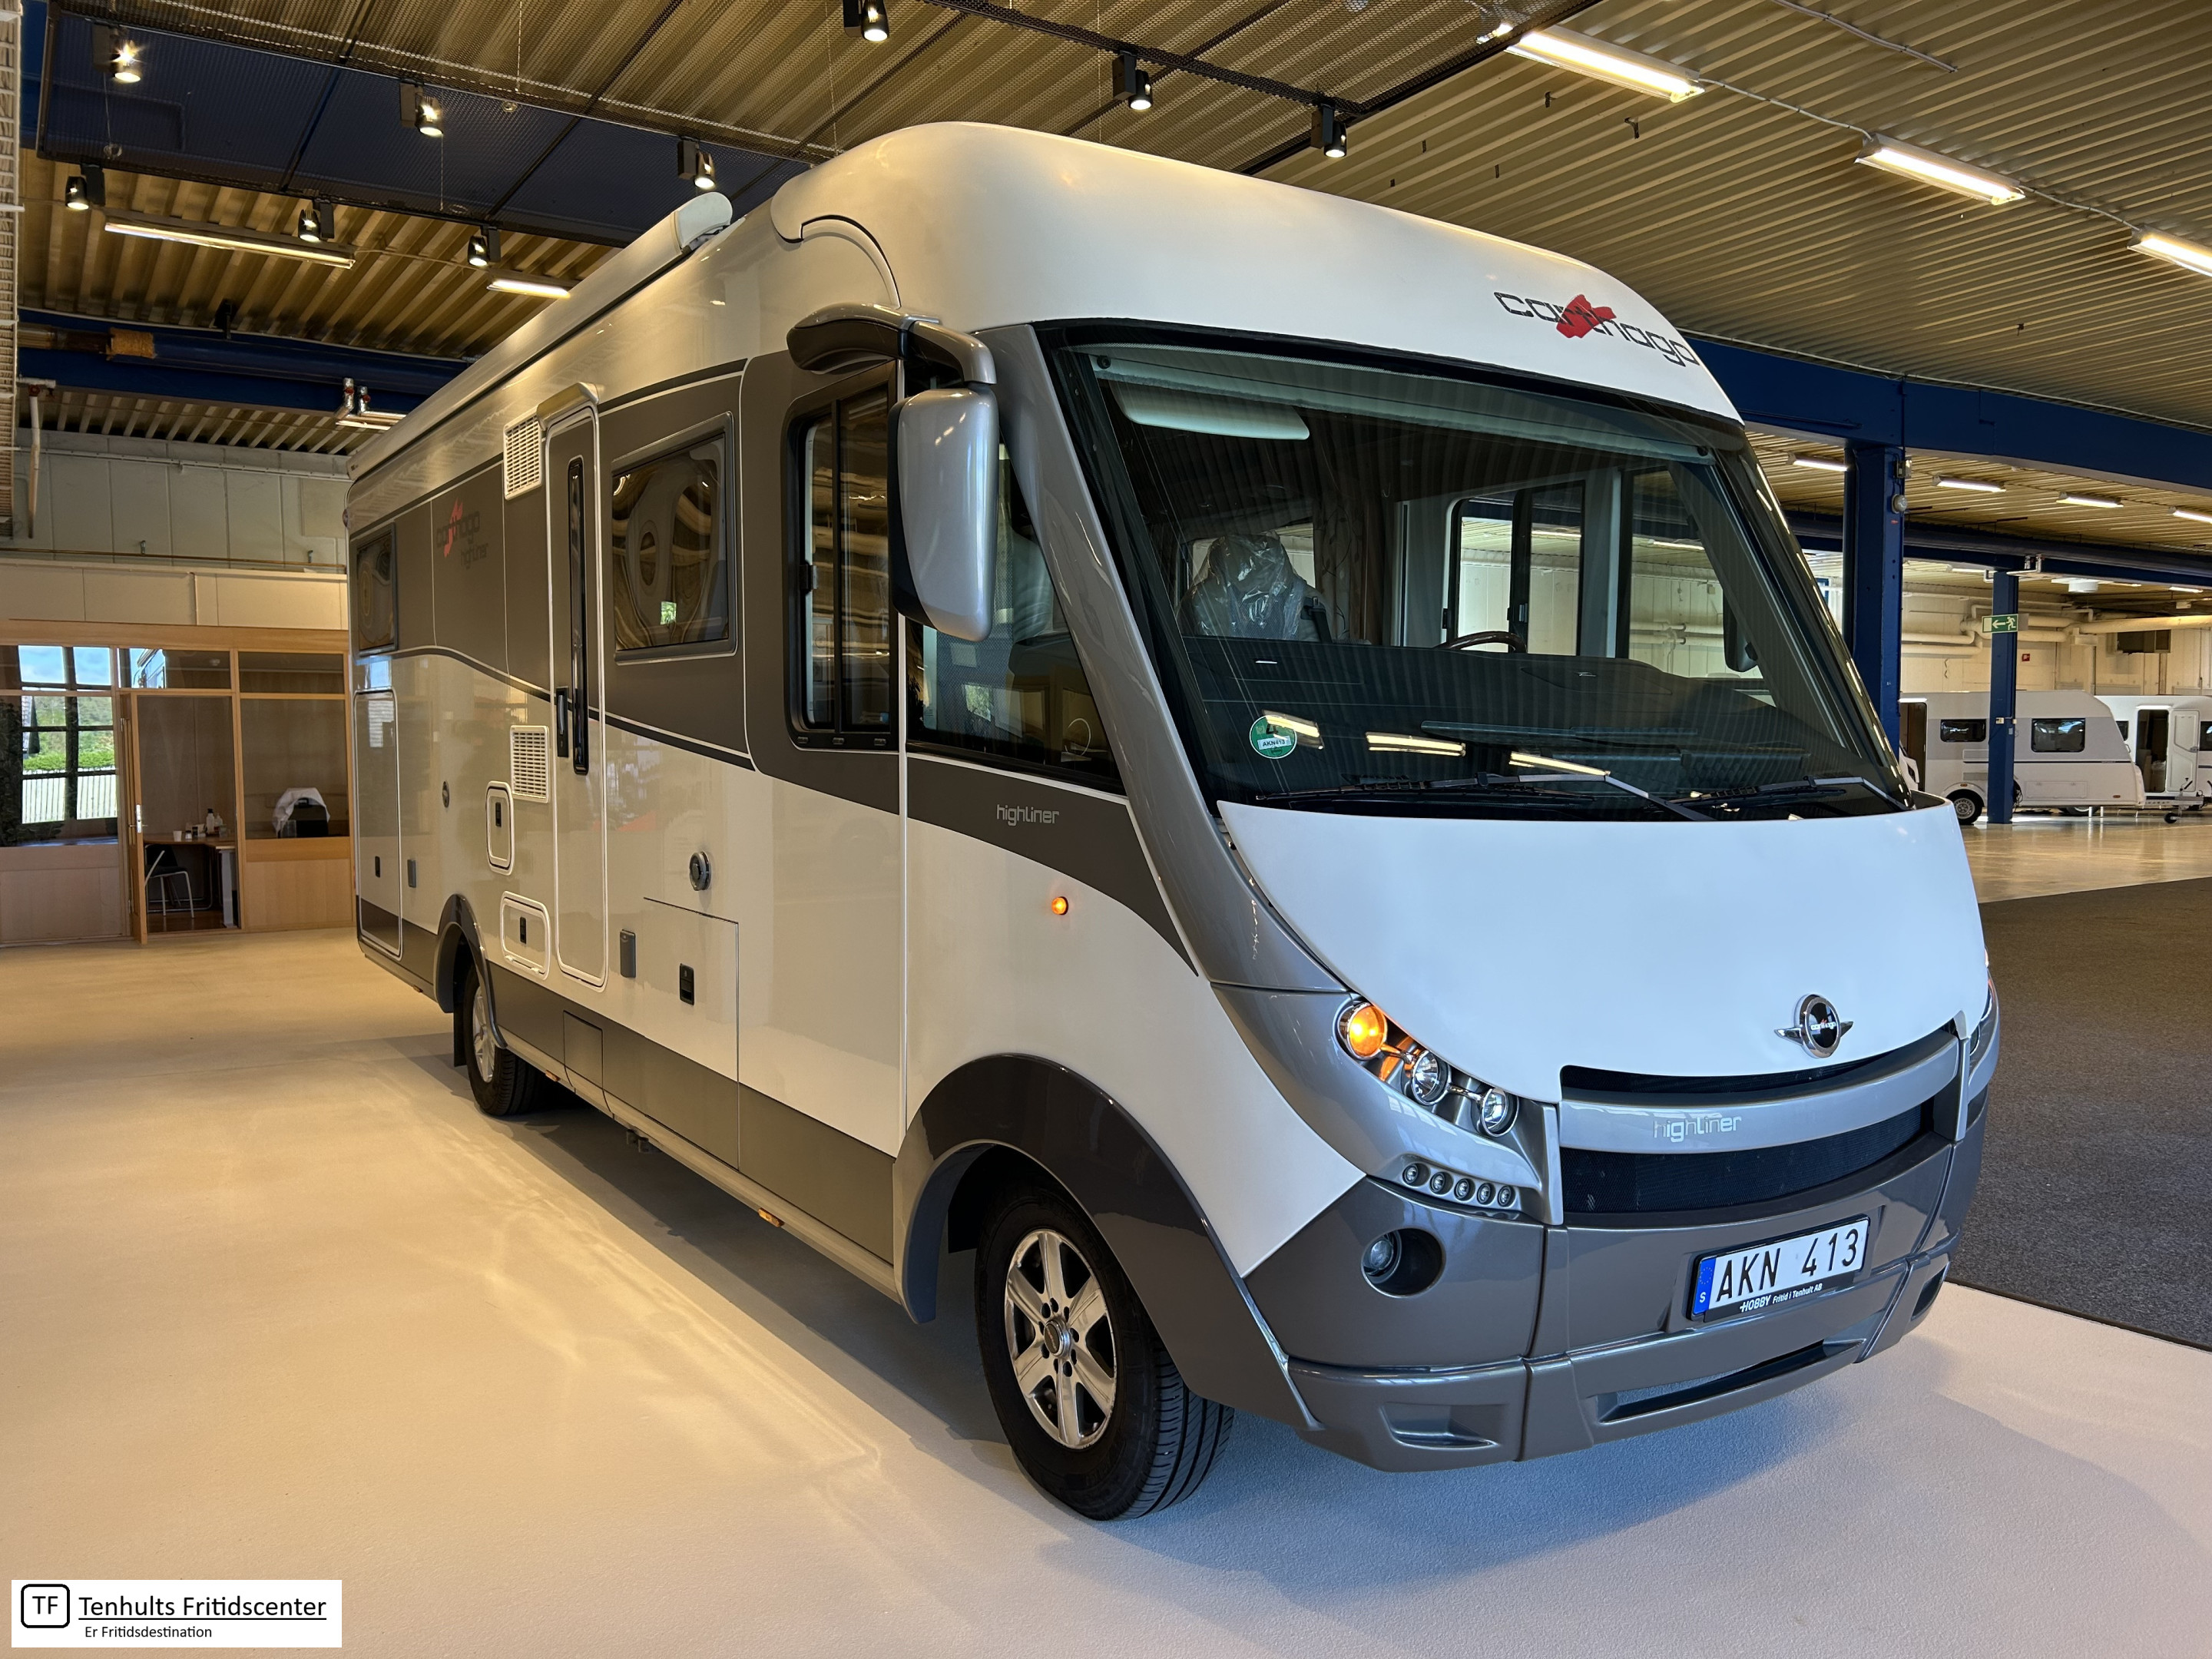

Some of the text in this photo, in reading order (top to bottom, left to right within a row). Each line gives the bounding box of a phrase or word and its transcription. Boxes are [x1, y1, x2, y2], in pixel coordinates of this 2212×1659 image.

[1493, 291, 1700, 368] carthago
[1262, 739, 1286, 747] AKN413
[996, 803, 1060, 826] highliner
[1652, 1115, 1743, 1144] highliner
[1715, 1228, 1859, 1303] AKN 413
[1698, 1290, 1707, 1304] S
[1739, 1294, 1772, 1313] HOBBY
[1773, 1292, 1789, 1304] Fritid
[1793, 1286, 1814, 1298] Tenhult
[1813, 1283, 1823, 1292] AB
